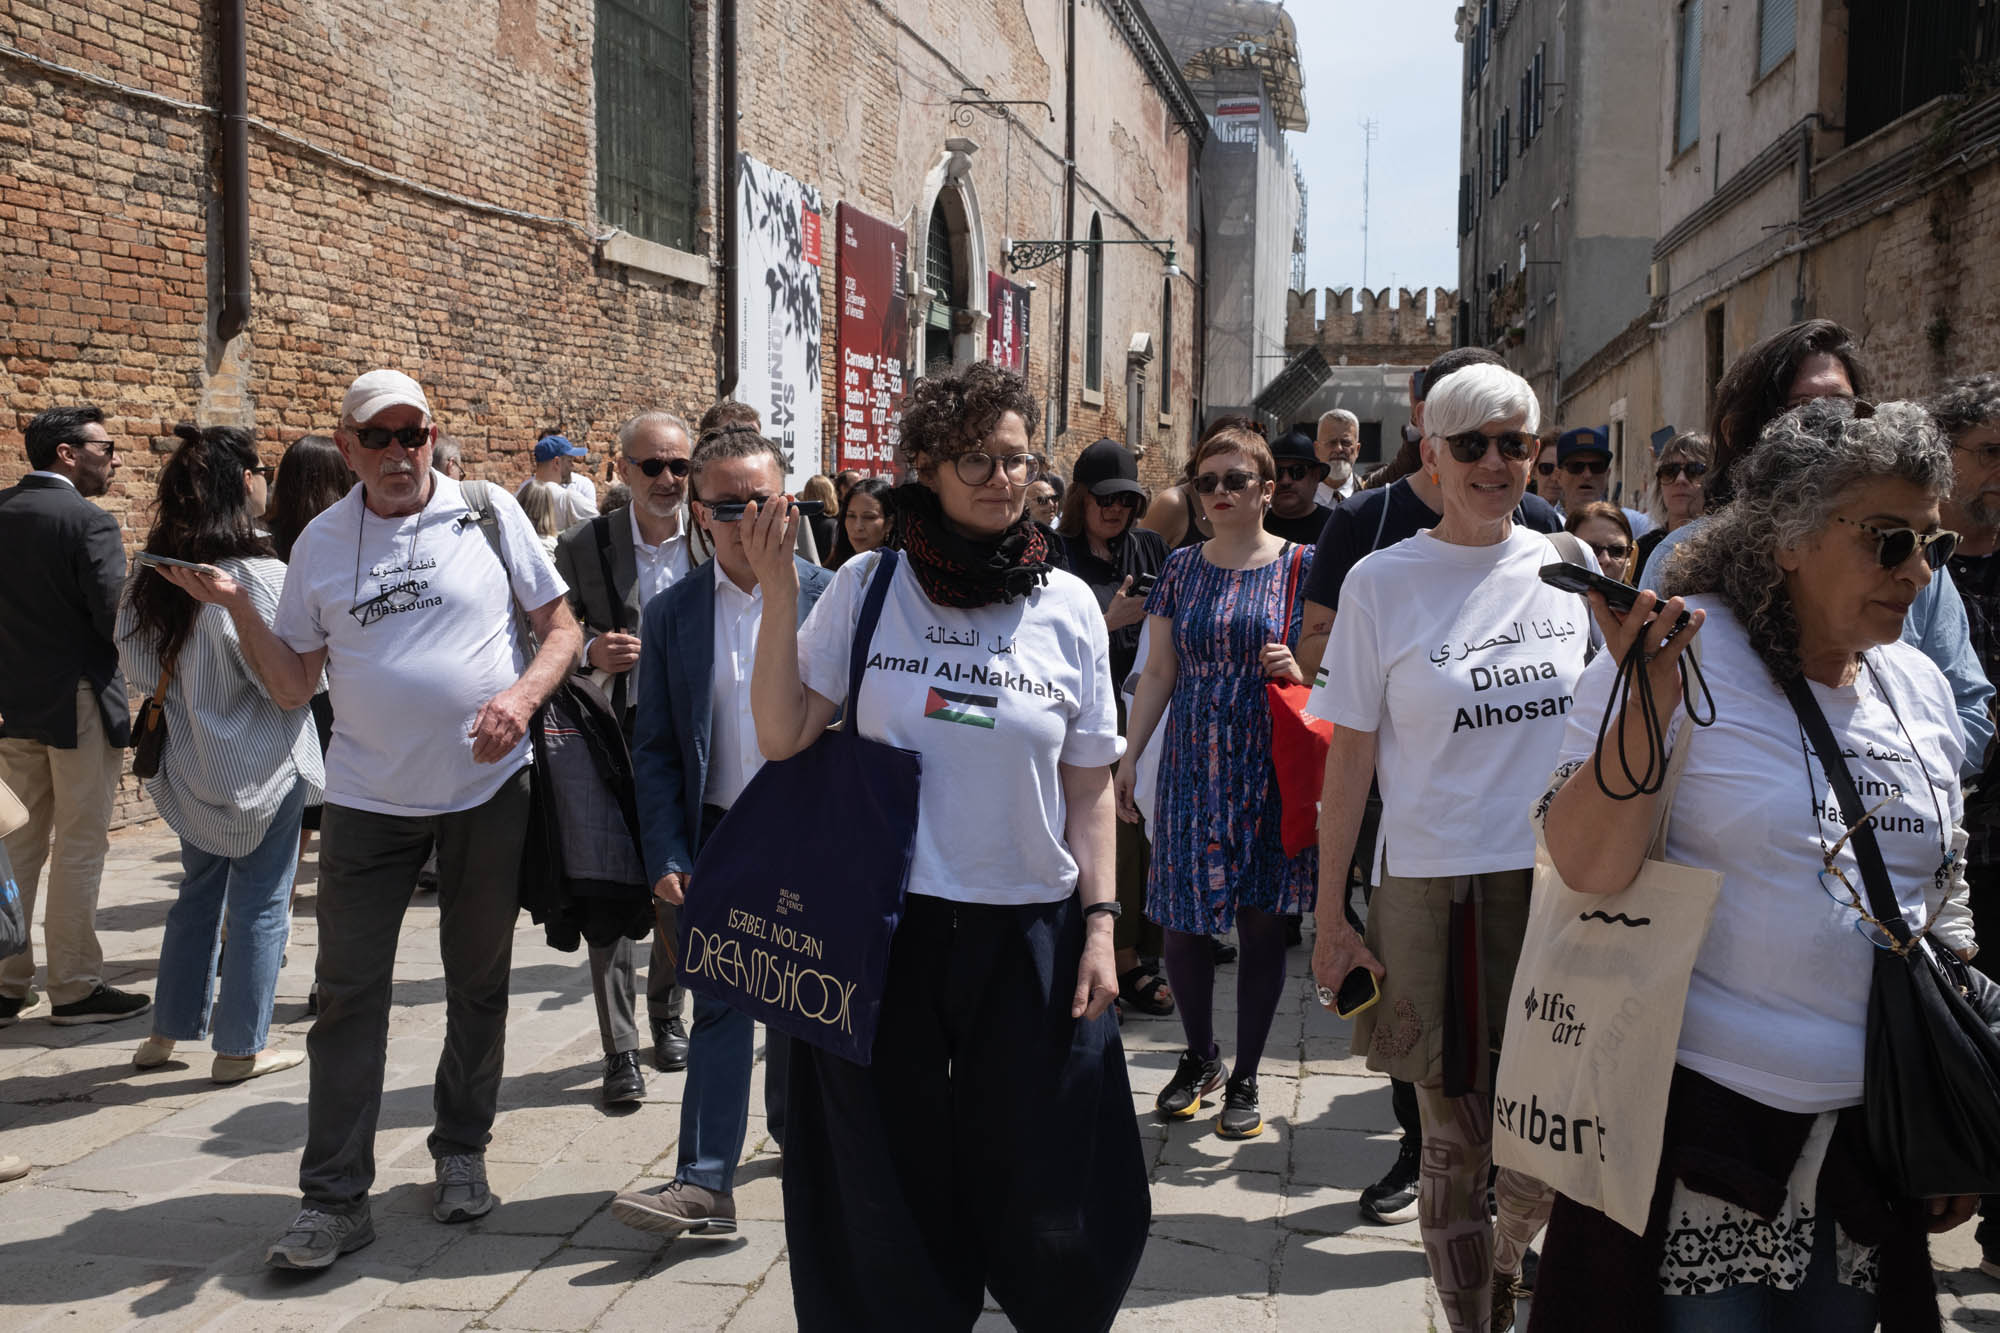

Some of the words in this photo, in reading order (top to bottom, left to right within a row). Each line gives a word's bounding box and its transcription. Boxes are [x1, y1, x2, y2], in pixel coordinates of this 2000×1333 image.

[845, 347, 874, 371] Carnevale
[844, 366, 859, 386] Arte
[844, 384, 864, 405] Teatro
[844, 403, 864, 424] Danza
[783, 383, 795, 475] KEYS
[844, 422, 867, 442] Cinema
[844, 441, 866, 460] Musica
[925, 625, 980, 647] النخالة
[1531, 618, 1576, 643] ديانا
[1430, 621, 1527, 668] الحصري
[866, 653, 929, 675] Amal
[934, 662, 1066, 702] Al-Nakhala
[1470, 661, 1558, 692] Diana
[1812, 797, 1925, 834] Hasouna
[728, 908, 767, 939] ISABEL
[770, 923, 823, 960] NOLAN
[686, 927, 857, 1035] DREAMSHOOK
[1539, 993, 1576, 1023] Ifis
[1551, 1022, 1586, 1047] art
